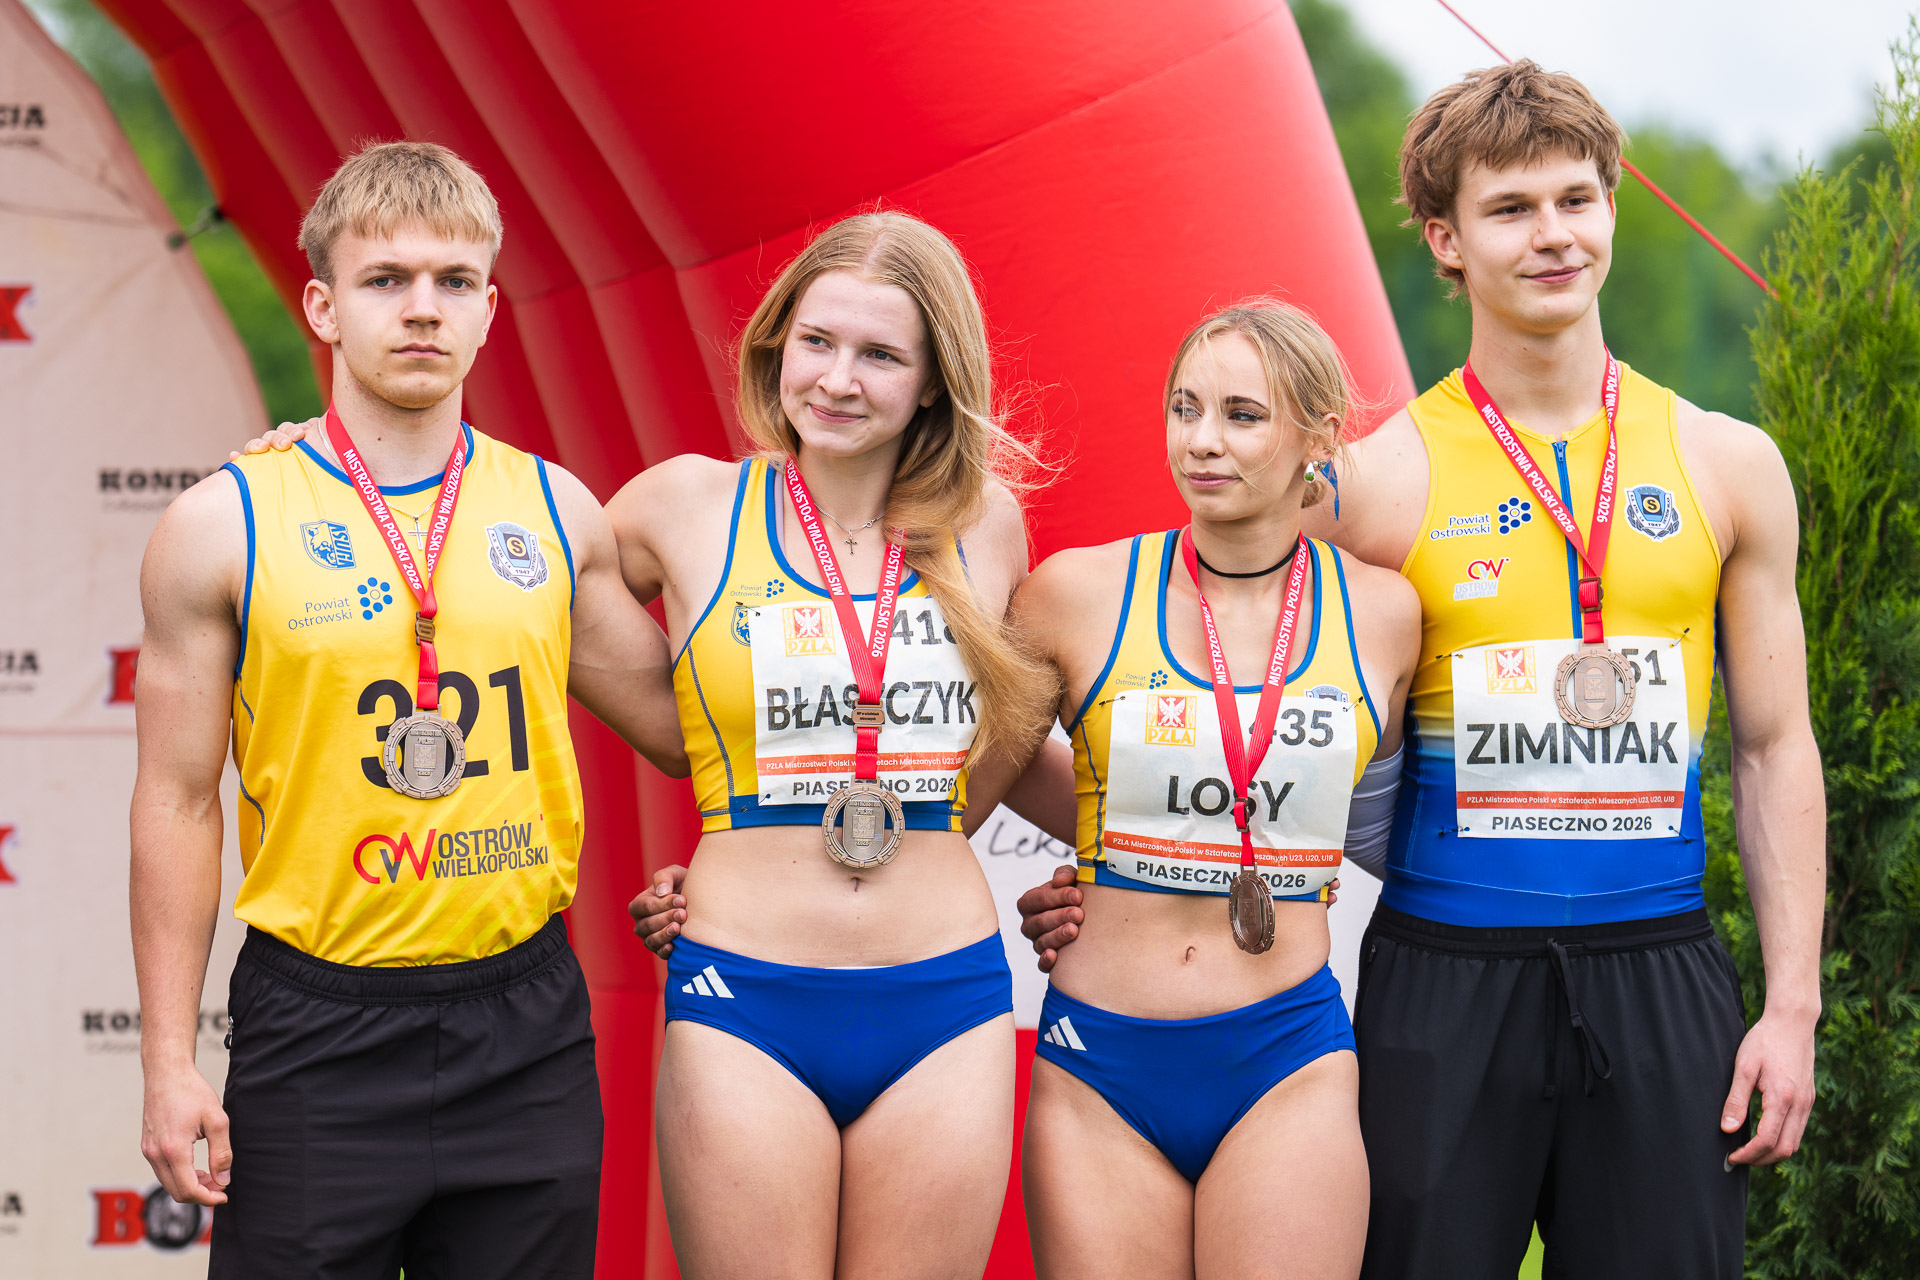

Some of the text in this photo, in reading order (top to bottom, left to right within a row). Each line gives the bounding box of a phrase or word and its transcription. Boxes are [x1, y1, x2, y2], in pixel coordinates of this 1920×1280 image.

[98, 467, 214, 493] KOND
[439, 447, 464, 514] MISTRZOSTWA
[1481, 403, 1576, 533] MISTRZOSTWA POLSKI 2026
[1601, 452, 1616, 494] POLSKI
[792, 483, 815, 522] POLSKI
[1597, 494, 1611, 523] 2026
[1647, 499, 1658, 511] S
[343, 448, 422, 590] MISTRZOSTWA POLSKI 2026
[1430, 524, 1491, 540] Ostrowski
[1449, 514, 1490, 526] Powiat
[429, 514, 449, 552] POLSKI
[511, 539, 523, 554] S
[807, 521, 845, 596] MISTRZOSTWA
[305, 597, 350, 613] Powiat
[876, 588, 894, 628] POLSKI
[1267, 542, 1307, 686] MISTRZOSTWA POLSKI 2026
[288, 608, 353, 630] Ostrowski
[787, 639, 833, 654] PZLA
[871, 630, 886, 657] 2026
[1125, 673, 1146, 681] Powiat
[1608, 648, 1667, 685] 51
[1115, 678, 1145, 687] Ostrowski
[1490, 678, 1533, 691] PZLA
[766, 681, 979, 731] BŁASCZYK
[1147, 728, 1192, 744] PZLA
[1249, 708, 1334, 747] 35
[1466, 721, 1678, 764] ZIMNIAK
[785, 760, 827, 769] Mistrzostwa
[829, 759, 850, 767] Polski
[899, 757, 941, 767] Mieszanych
[793, 779, 910, 796] PIASENO
[1485, 796, 1527, 804] Mistrzostwa
[1529, 796, 1549, 804] Polski
[1558, 796, 1597, 804] Sztafetach
[1598, 796, 1638, 806] Mieszanych
[1638, 796, 1649, 804] U23,
[1664, 795, 1675, 803] U18
[1492, 815, 1652, 832] PIASECZNO 2026
[438, 819, 532, 858] OSTRÓW
[1113, 837, 1129, 846] PZLA
[1130, 840, 1174, 853] Mistrzostwa
[1174, 846, 1196, 855] Polski
[1255, 853, 1288, 863] eszanych
[1289, 855, 1304, 863] U23,
[1305, 855, 1320, 863] U20,
[432, 846, 549, 879] WIELKOPOLSKI
[1137, 861, 1237, 885] PIASECZN
